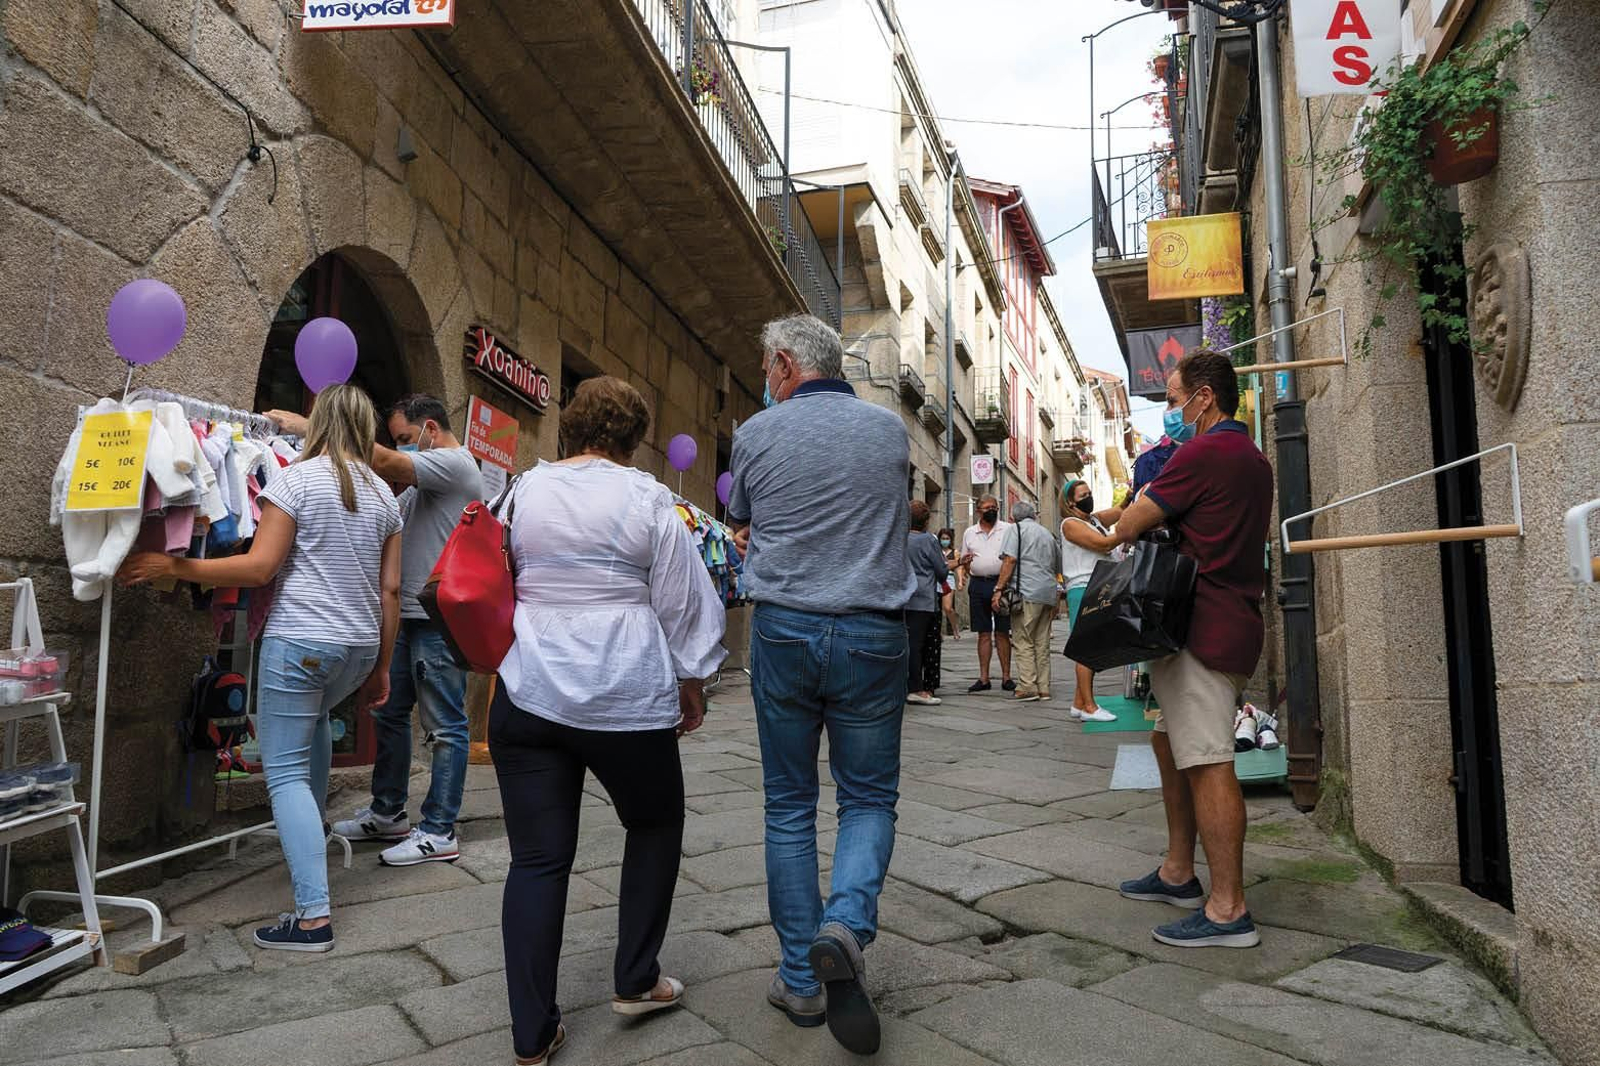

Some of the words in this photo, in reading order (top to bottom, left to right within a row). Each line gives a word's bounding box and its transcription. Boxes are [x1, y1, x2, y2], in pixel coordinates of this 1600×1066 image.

[309, 0, 411, 21] mayoral
[469, 435, 513, 468] TEMPORADA
[85, 459, 100, 468] 5€
[118, 456, 136, 466] 10€
[78, 482, 98, 491] 15€
[112, 480, 132, 490] 20€
